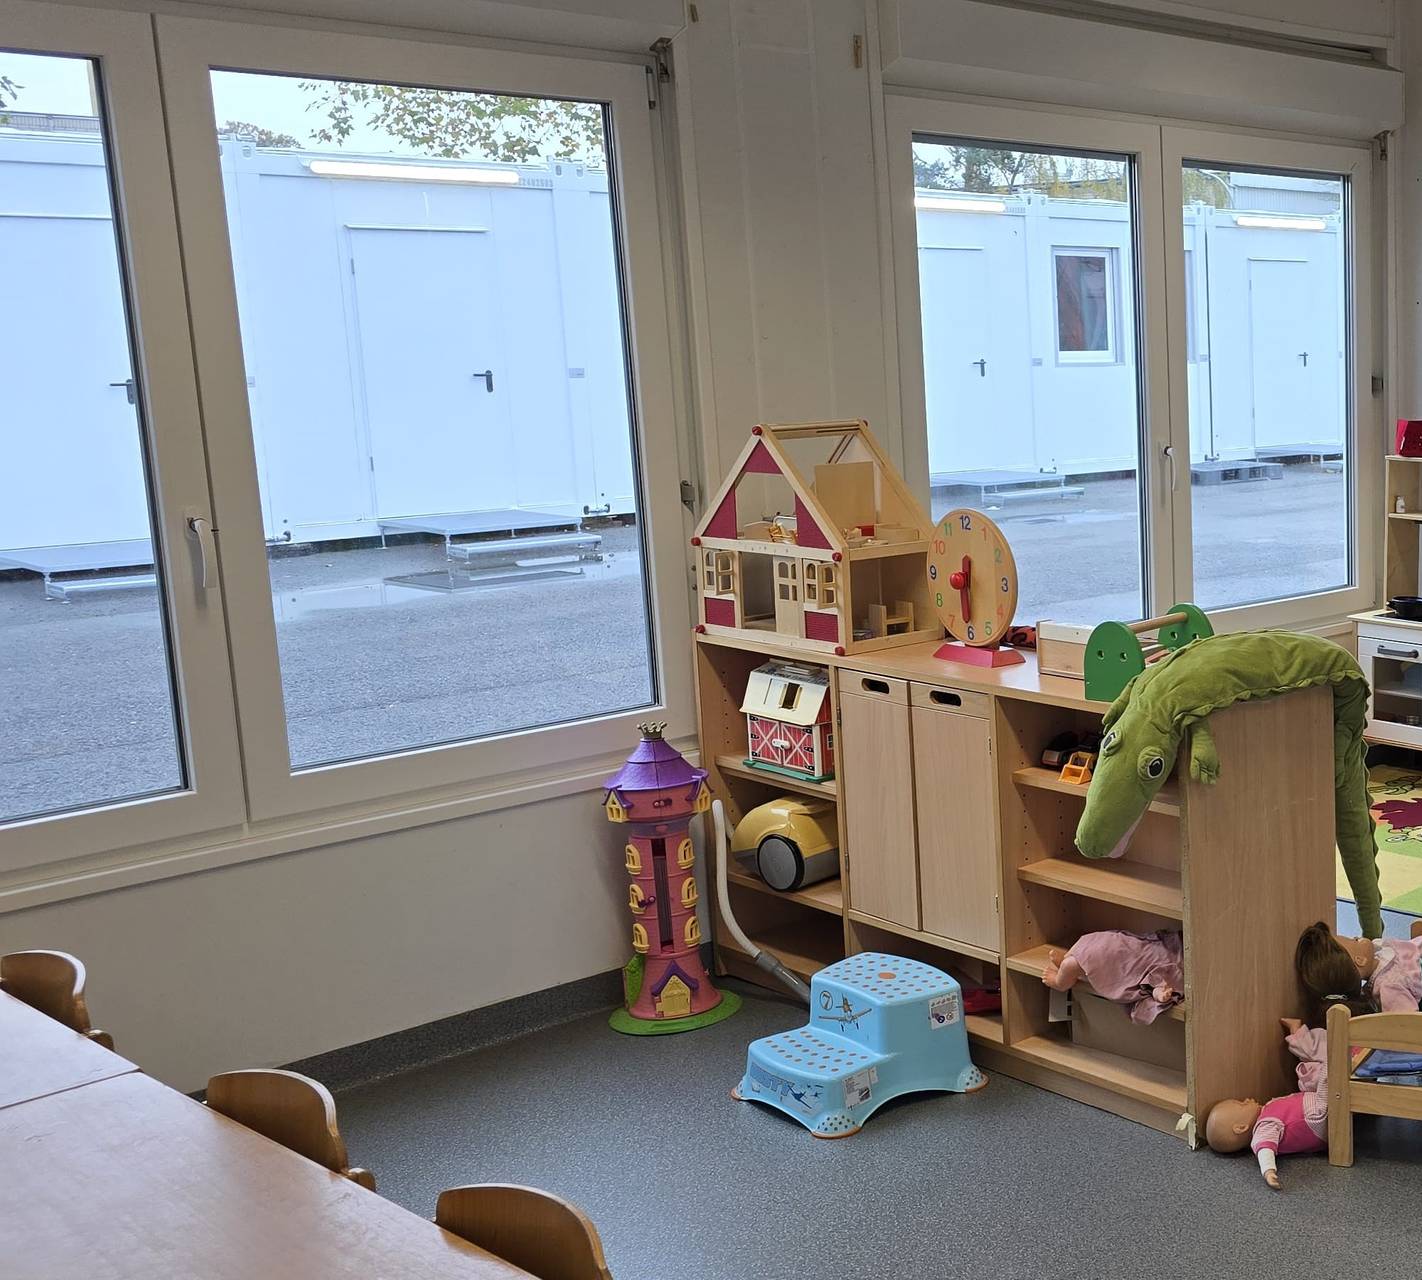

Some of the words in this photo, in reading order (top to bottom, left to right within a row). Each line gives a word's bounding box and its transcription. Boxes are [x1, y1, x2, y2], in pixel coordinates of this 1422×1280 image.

[944, 522, 953, 537] 11
[959, 515, 971, 531] 12
[981, 526, 987, 541] 1
[934, 540, 945, 555] 10
[994, 547, 1001, 563] 2
[929, 564, 937, 580] 9
[1001, 577, 1009, 592] 3
[936, 592, 943, 608] 8
[948, 614, 955, 629] 7
[984, 621, 992, 636] 5
[967, 625, 975, 641] 6
